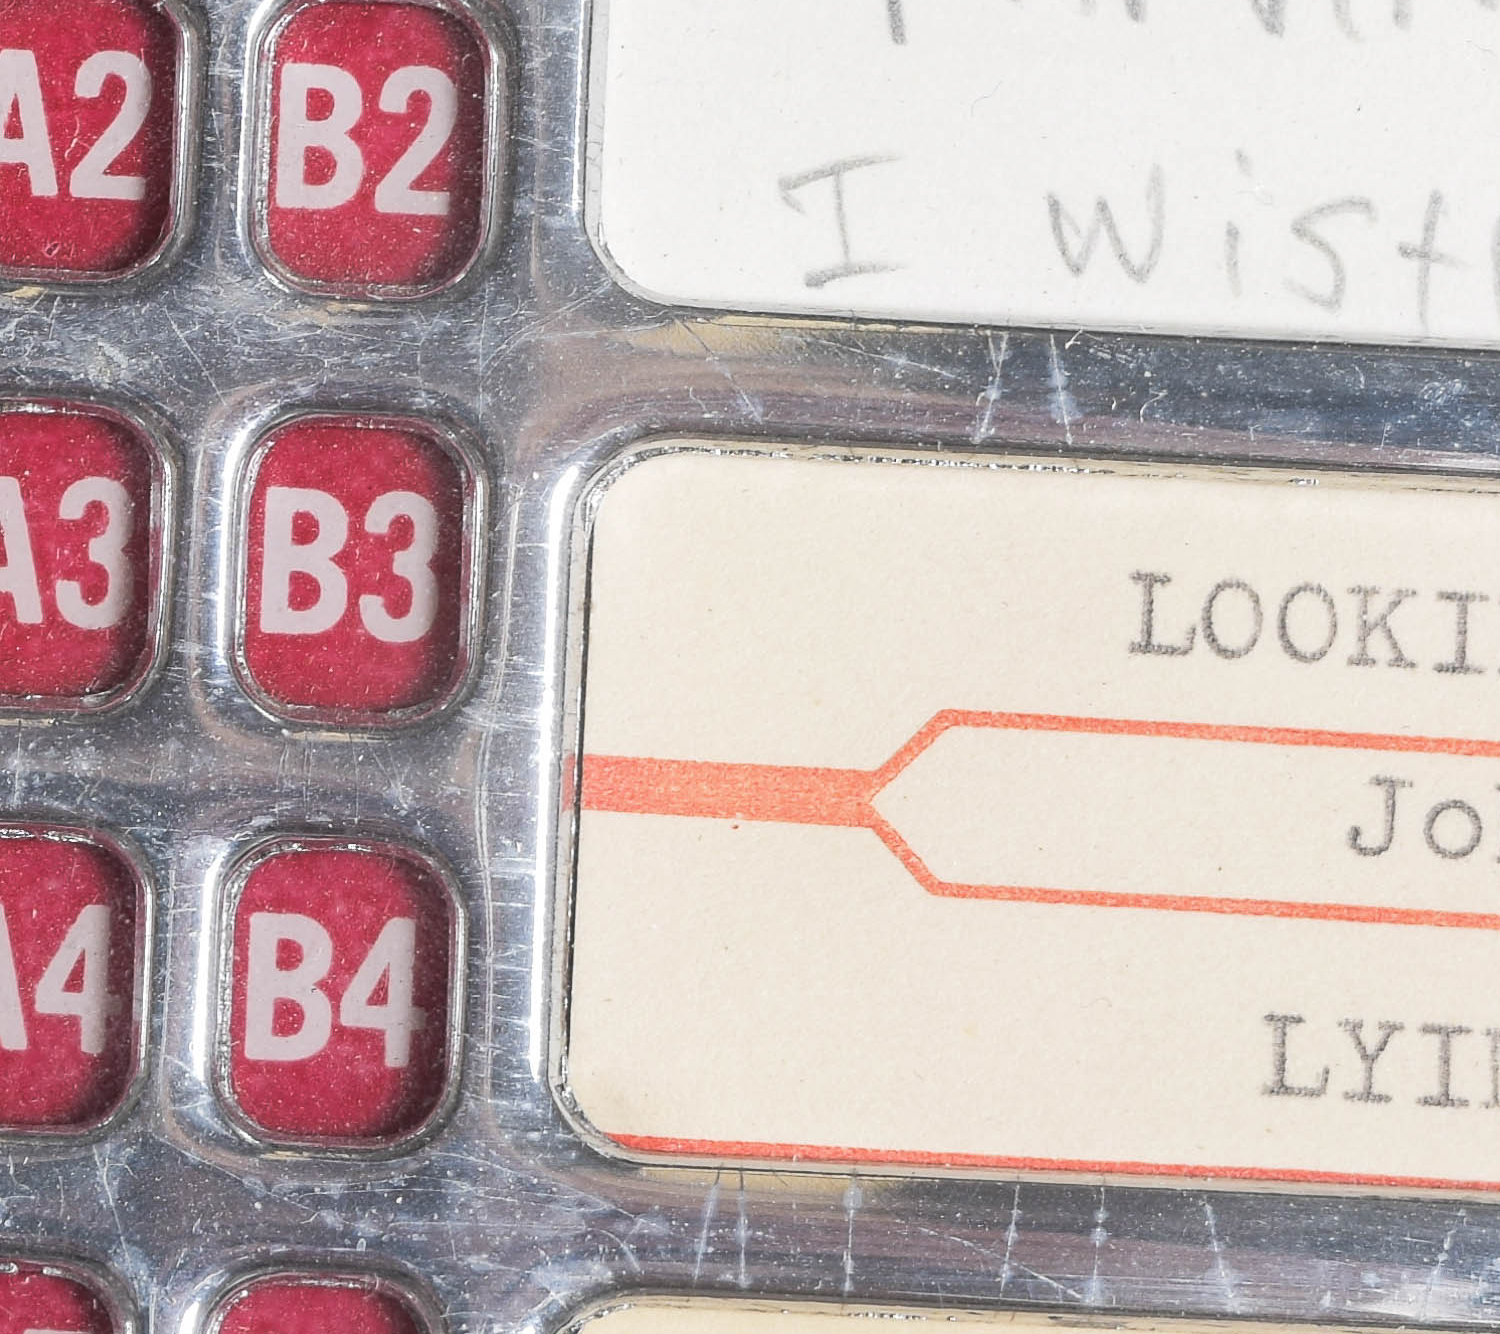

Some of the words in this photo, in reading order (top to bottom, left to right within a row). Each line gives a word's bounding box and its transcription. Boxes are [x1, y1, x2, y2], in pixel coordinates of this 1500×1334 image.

[273, 60, 462, 217] B2
[777, 152, 904, 291] I
[257, 484, 441, 646] B3
[242, 910, 429, 1069] B4
